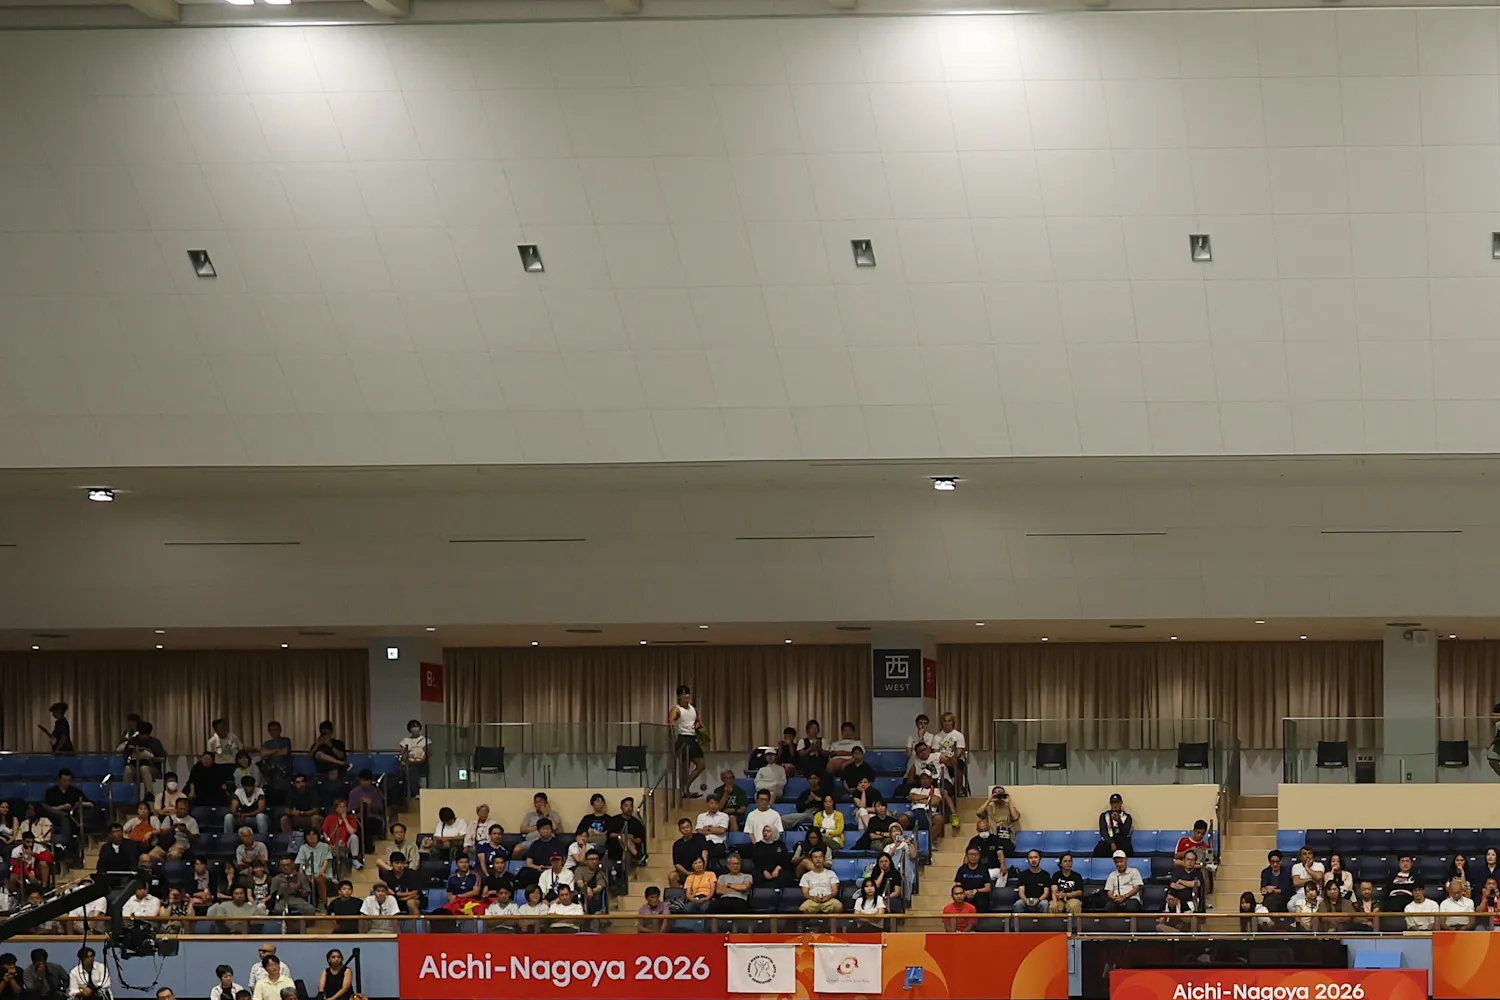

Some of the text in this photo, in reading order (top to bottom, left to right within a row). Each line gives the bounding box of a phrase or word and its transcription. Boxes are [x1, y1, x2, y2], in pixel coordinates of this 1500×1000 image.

[885, 655, 909, 679] 西
[418, 953, 626, 988] Aichi-Nagoya
[634, 955, 711, 981] 2026
[1314, 983, 1365, 1000] 2026
